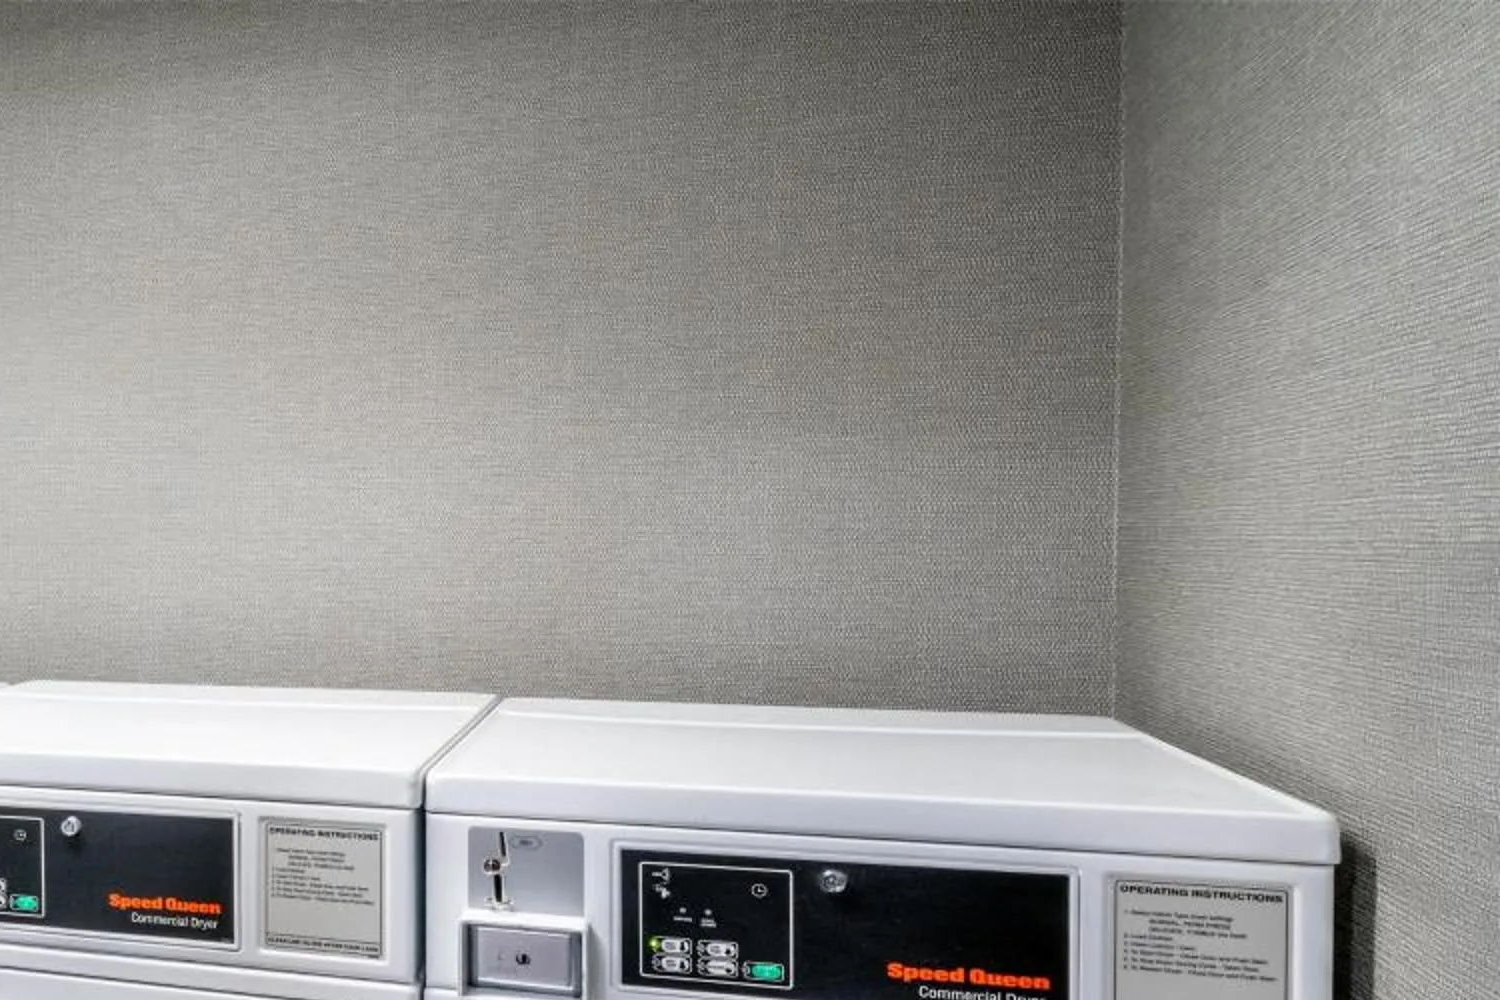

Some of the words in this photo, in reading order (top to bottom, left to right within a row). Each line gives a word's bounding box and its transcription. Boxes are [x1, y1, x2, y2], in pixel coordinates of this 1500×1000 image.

[108, 893, 162, 911] Speed
[166, 898, 221, 915] Queen
[1120, 885, 1188, 897] OPERATING
[1191, 890, 1283, 903] INSTRUCTIONS
[132, 911, 188, 927] Commercial
[191, 917, 218, 931] Dryer
[887, 962, 965, 984] Speed
[969, 968, 1050, 991] Queen
